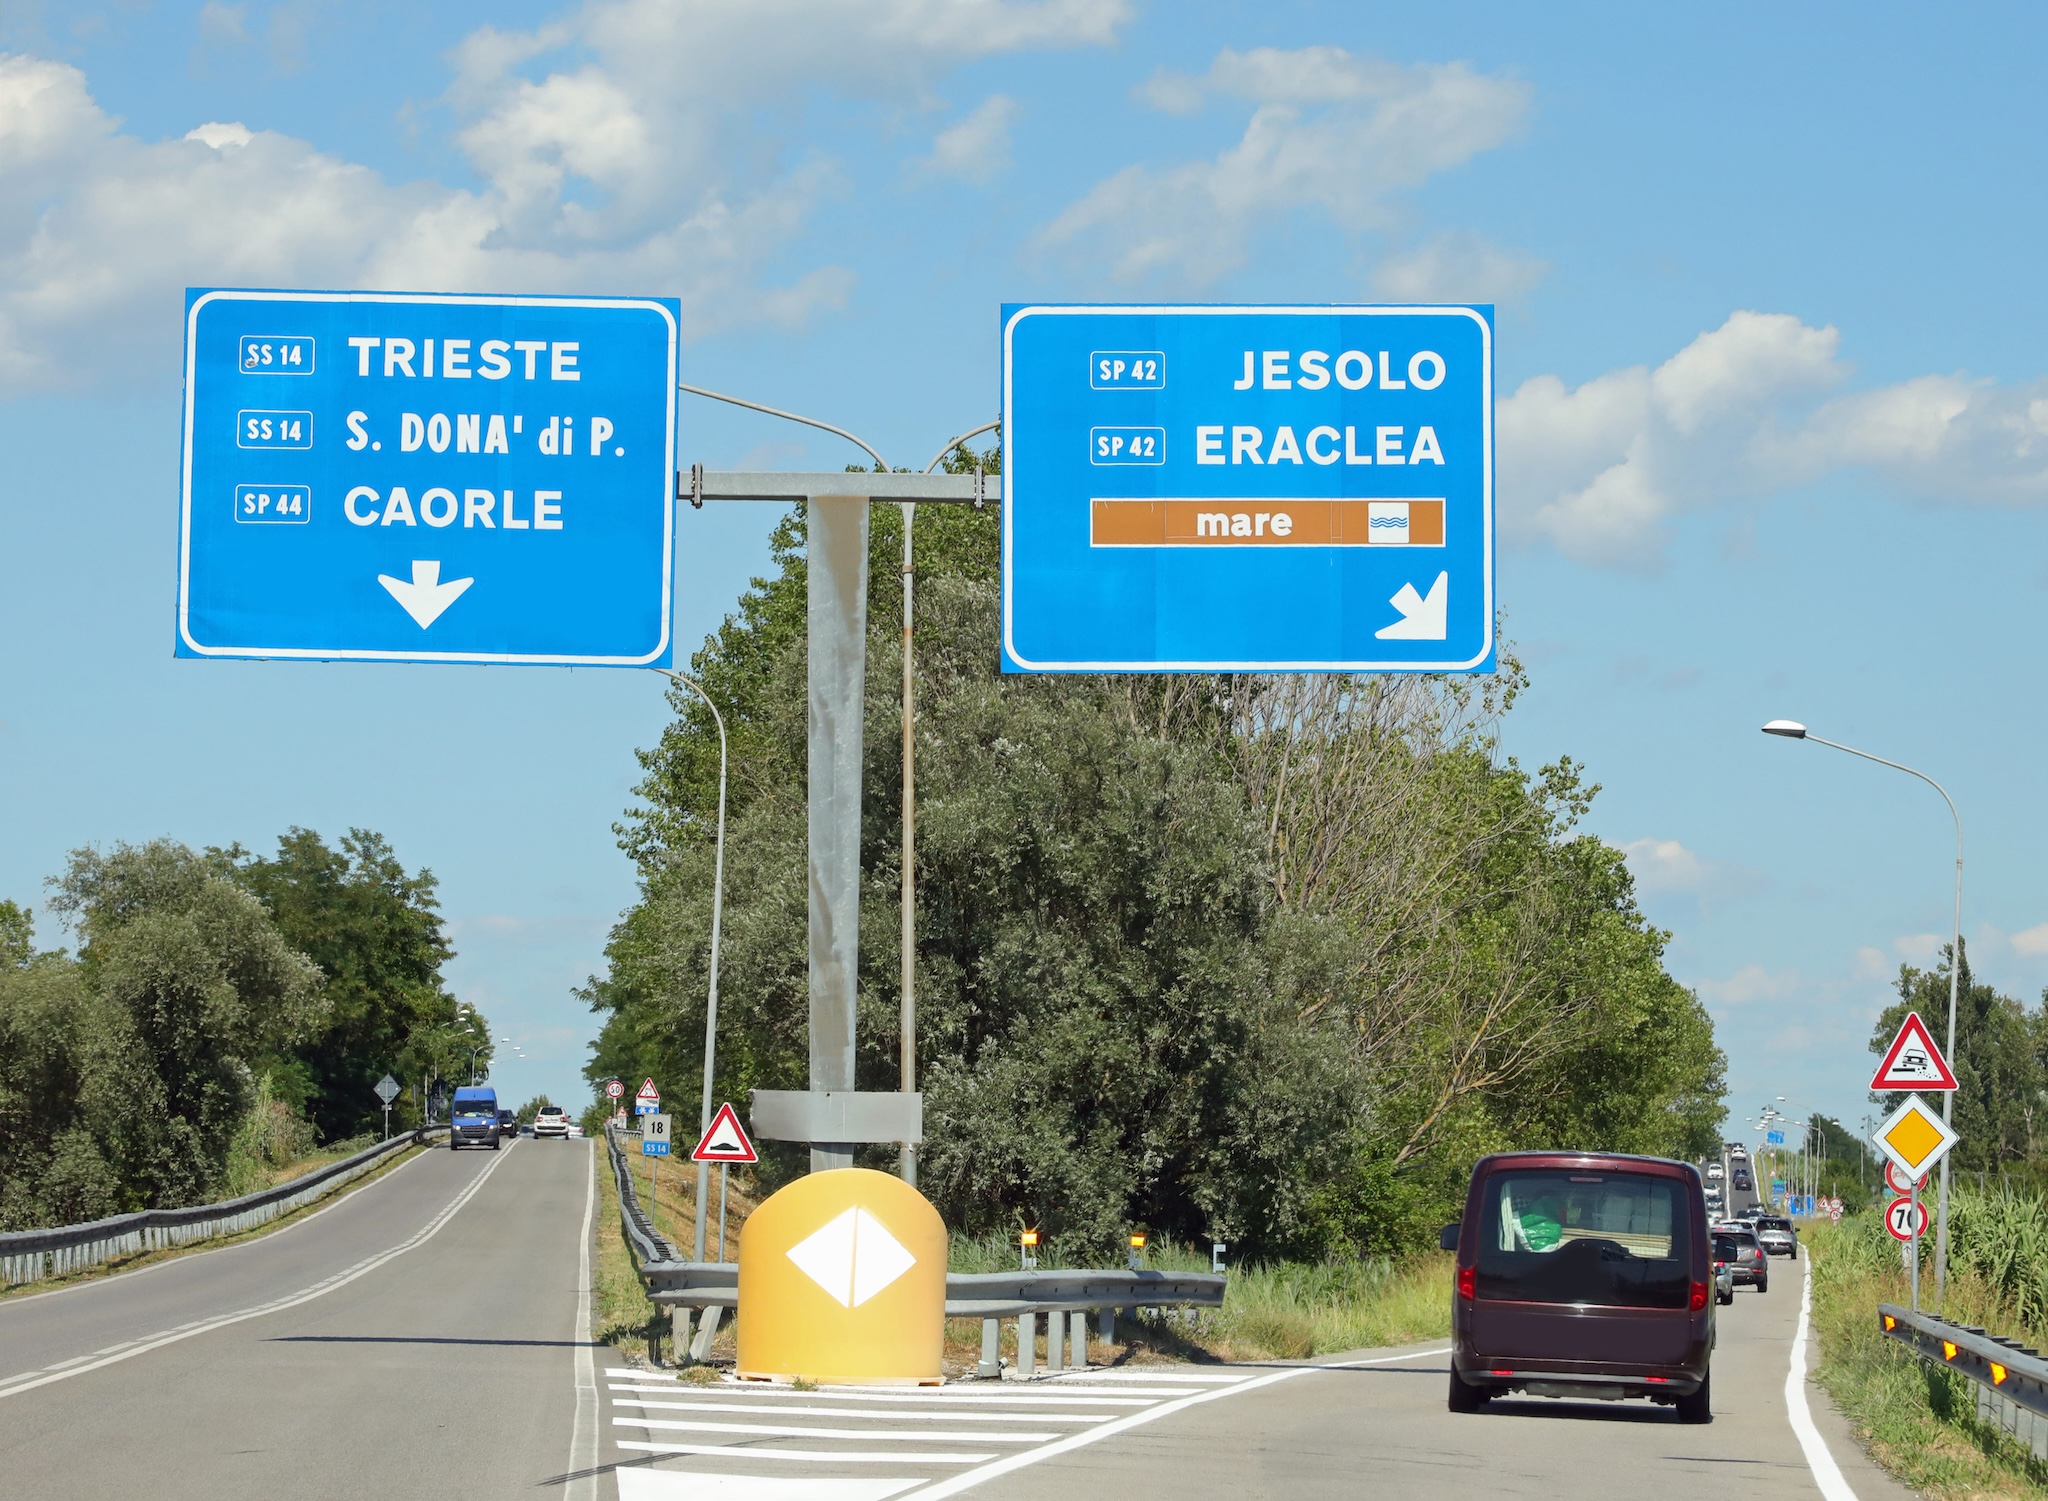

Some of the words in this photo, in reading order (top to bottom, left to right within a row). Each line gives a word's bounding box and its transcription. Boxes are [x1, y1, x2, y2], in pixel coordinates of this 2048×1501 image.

[245, 344, 272, 365] SS
[279, 345, 302, 366] 14
[348, 337, 581, 381] TRIESTE
[1099, 360, 1126, 381] SP
[1131, 360, 1157, 381] 42
[1233, 350, 1447, 391] JESOLO
[247, 419, 273, 440] SS
[279, 420, 302, 441] 14
[345, 410, 382, 451] S.
[400, 412, 523, 454] DONA'
[538, 417, 573, 455] di
[590, 416, 625, 457] P.
[1097, 436, 1124, 457] SP
[1129, 436, 1155, 457] 42
[1196, 425, 1446, 466] ERACLEA
[244, 493, 271, 515] SP
[275, 494, 302, 515] 44
[343, 486, 564, 530] CAORLE
[1196, 512, 1293, 537] mare
[652, 1122, 663, 1134] 18
[646, 1144, 655, 1152] SS
[658, 1144, 666, 1152] 14
